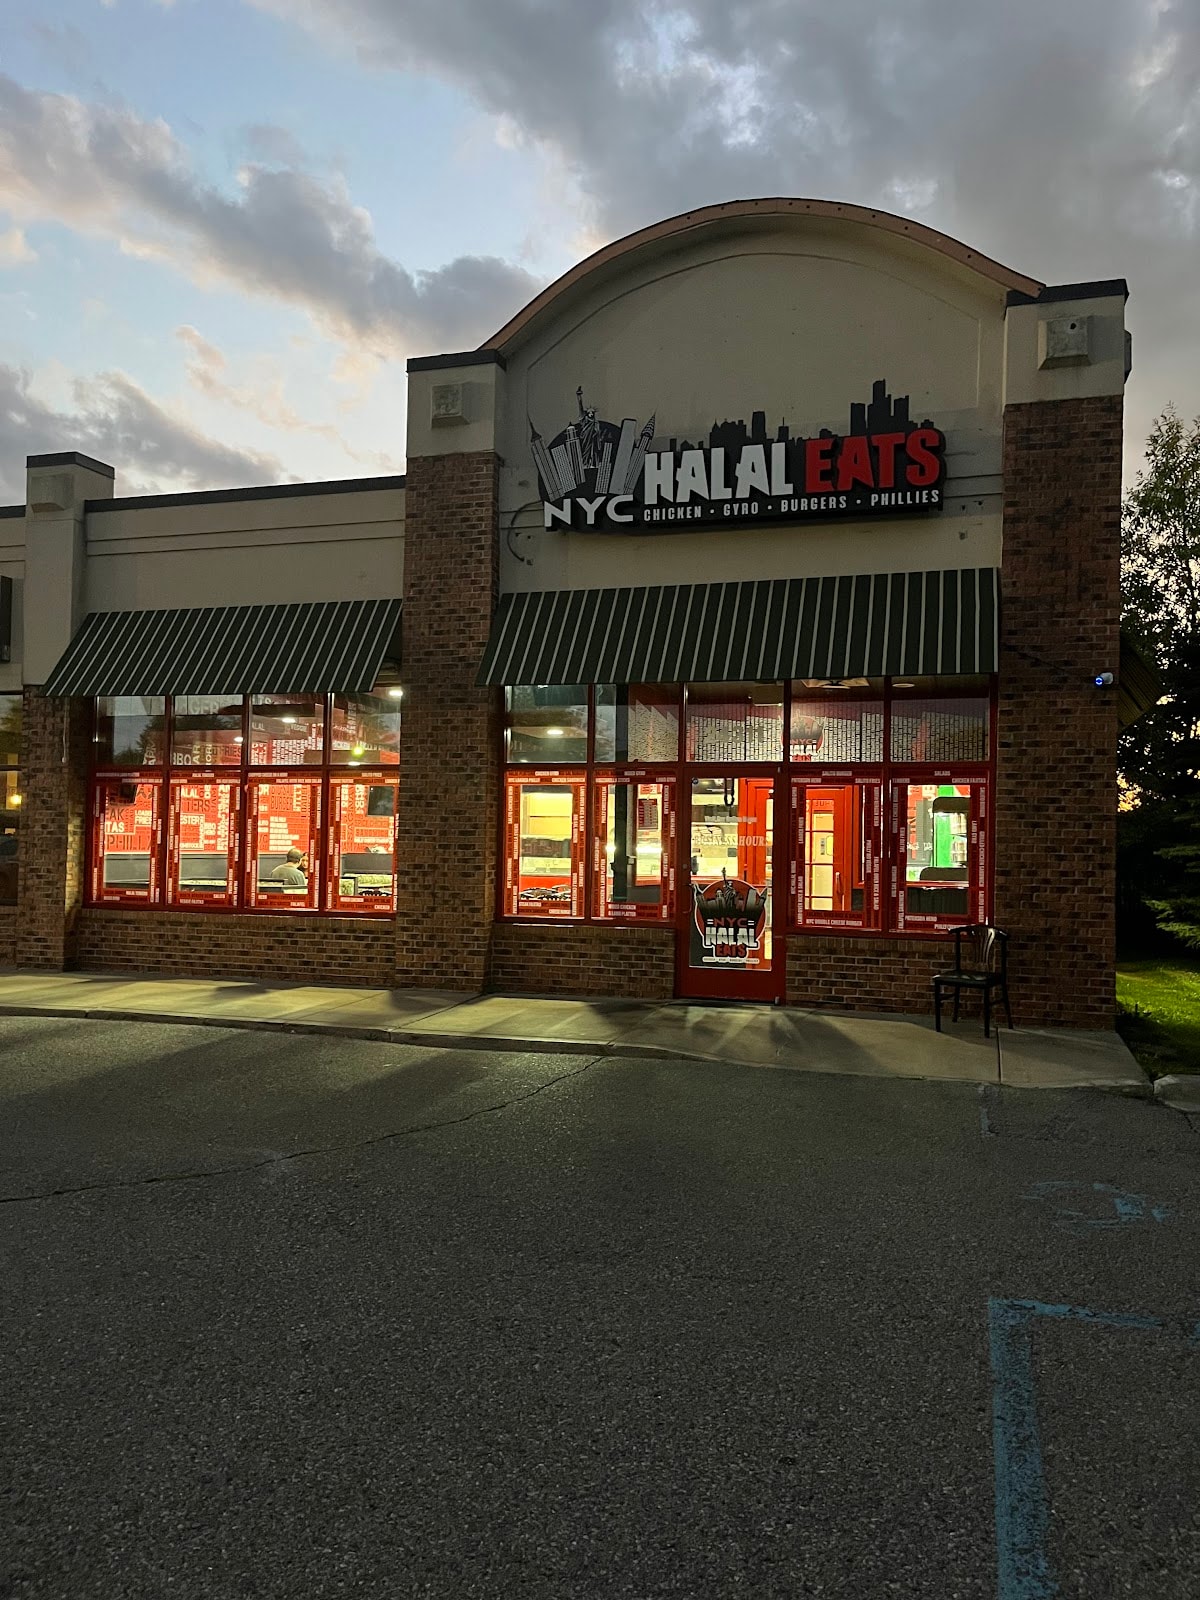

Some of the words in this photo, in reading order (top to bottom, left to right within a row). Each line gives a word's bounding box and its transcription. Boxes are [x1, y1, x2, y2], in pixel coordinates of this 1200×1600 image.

[645, 442, 793, 505] HALAL
[806, 428, 941, 493] EATS
[544, 494, 634, 527] NYC
[644, 505, 703, 522] CHICKEN
[723, 503, 760, 517] GYRO
[781, 495, 848, 513] BURGERS
[870, 488, 940, 507] PHILLIES
[713, 917, 748, 928] NYC
[705, 926, 757, 947] HALAL
[715, 944, 746, 957] EATS
